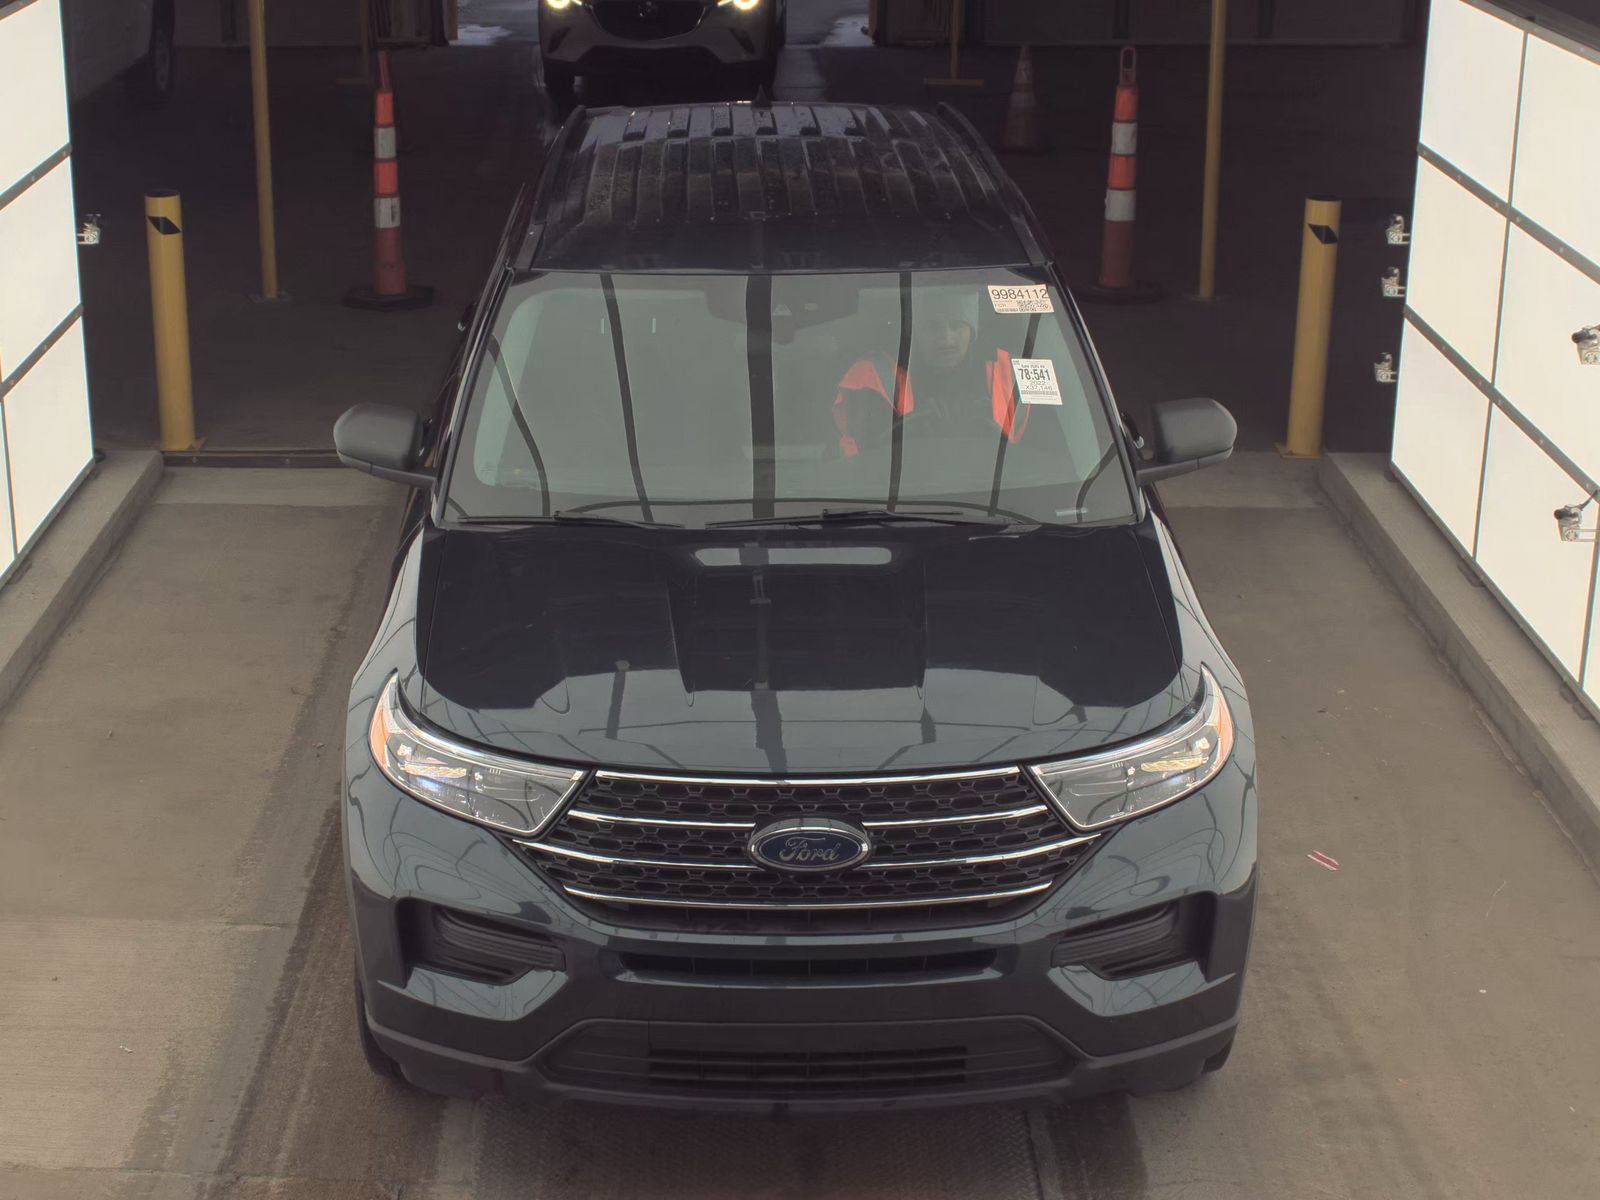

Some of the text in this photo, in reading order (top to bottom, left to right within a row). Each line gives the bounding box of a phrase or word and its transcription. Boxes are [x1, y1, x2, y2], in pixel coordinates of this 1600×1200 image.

[991, 288, 1050, 300] 9984112
[1018, 368, 1051, 381] 78:541
[779, 836, 841, 861] Ford
